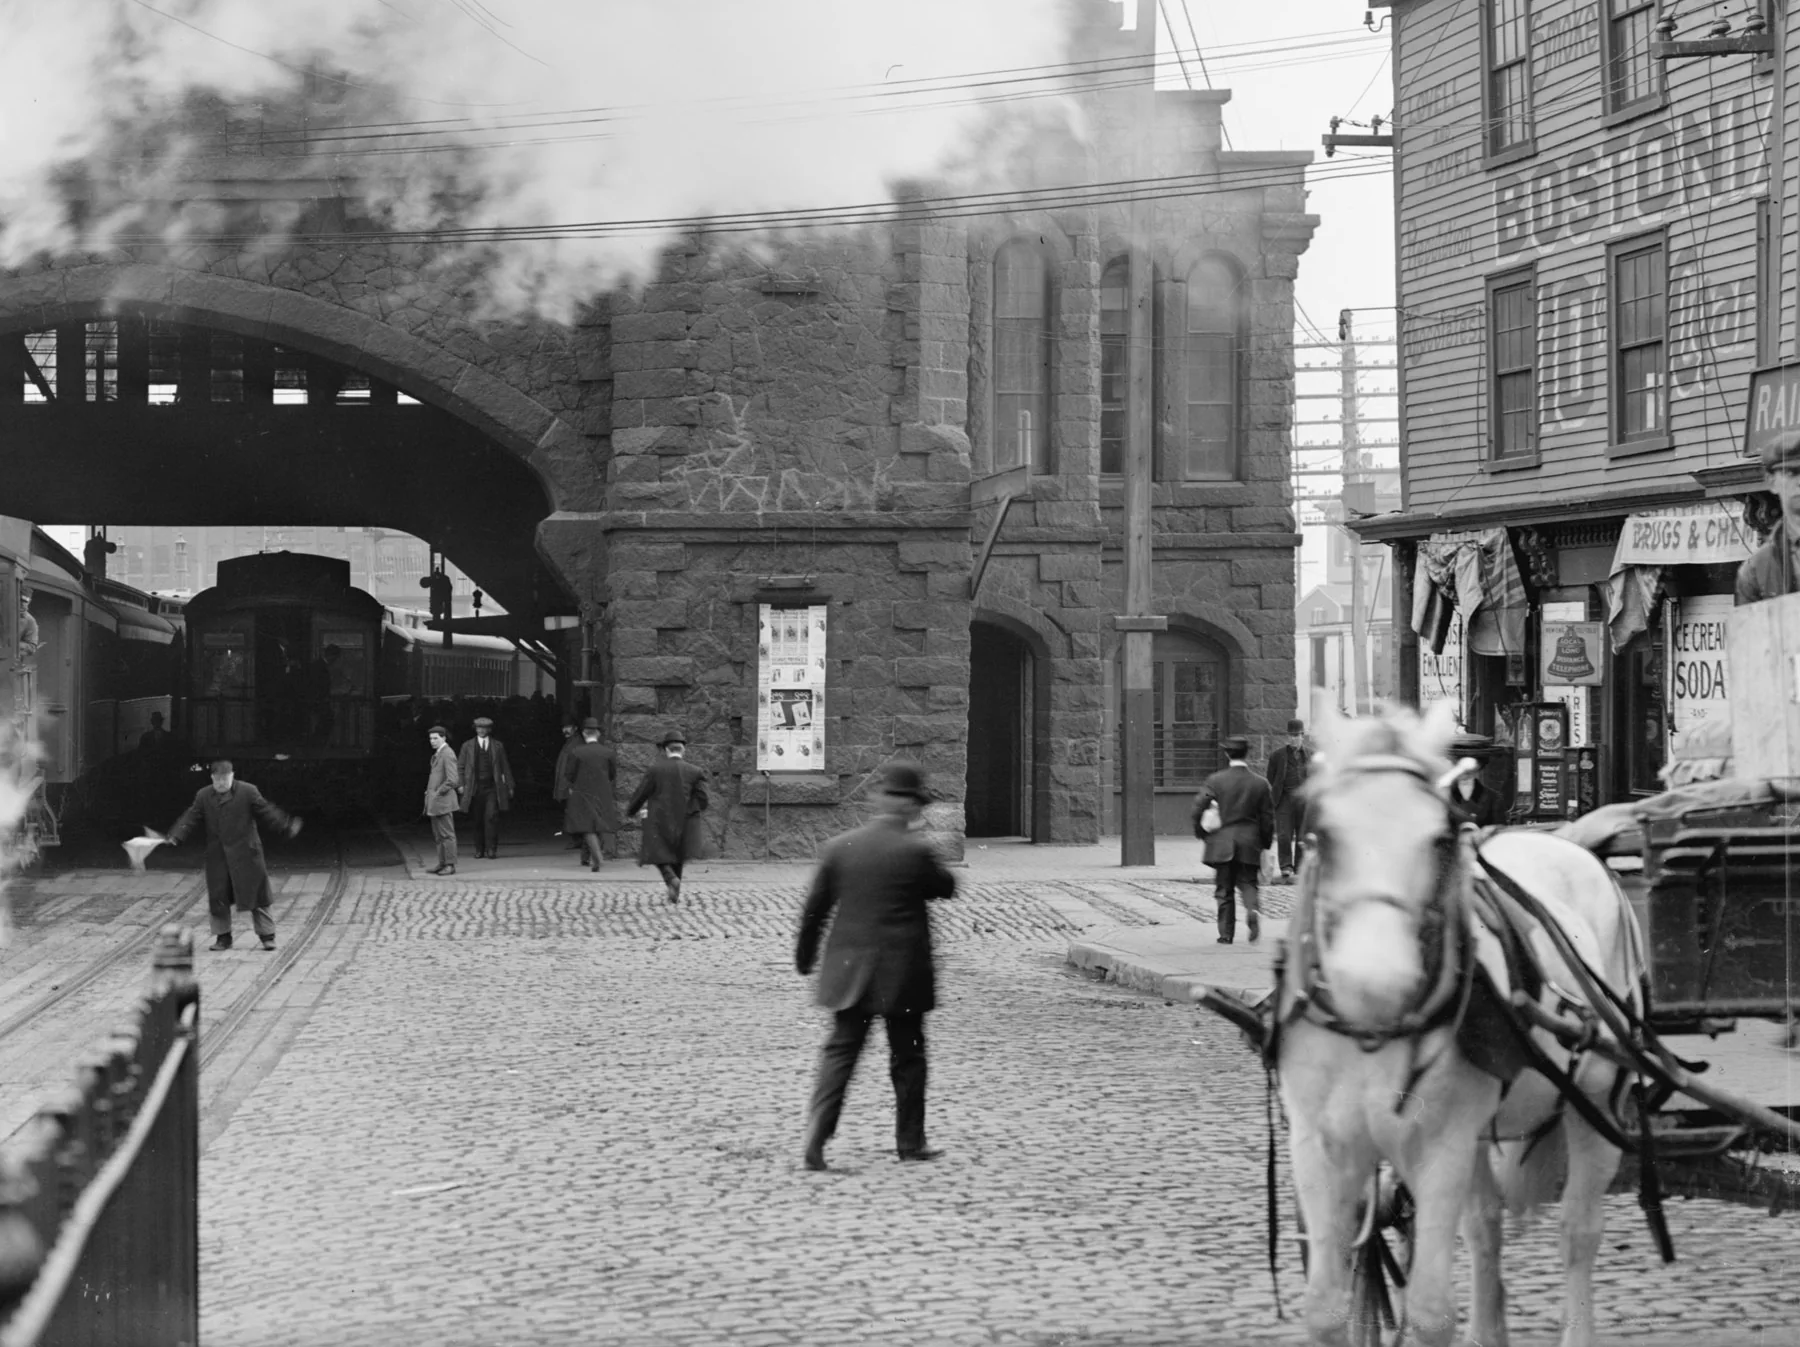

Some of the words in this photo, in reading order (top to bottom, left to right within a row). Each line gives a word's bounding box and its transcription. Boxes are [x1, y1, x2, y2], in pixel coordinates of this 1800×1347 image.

[1408, 78, 1462, 126] LOVELL
[1407, 219, 1474, 277] Reputation
[1537, 269, 1607, 433] 10
[1755, 382, 1800, 432] RAI
[1632, 519, 1682, 551] DRUGS
[1687, 519, 1701, 550] &
[1674, 622, 1690, 652] CE
[1423, 653, 1458, 677] EMOLLIEN
[1552, 663, 1589, 672] TELEPHONE
[1556, 655, 1585, 663] DISTANCE
[1675, 659, 1726, 700] SODA
